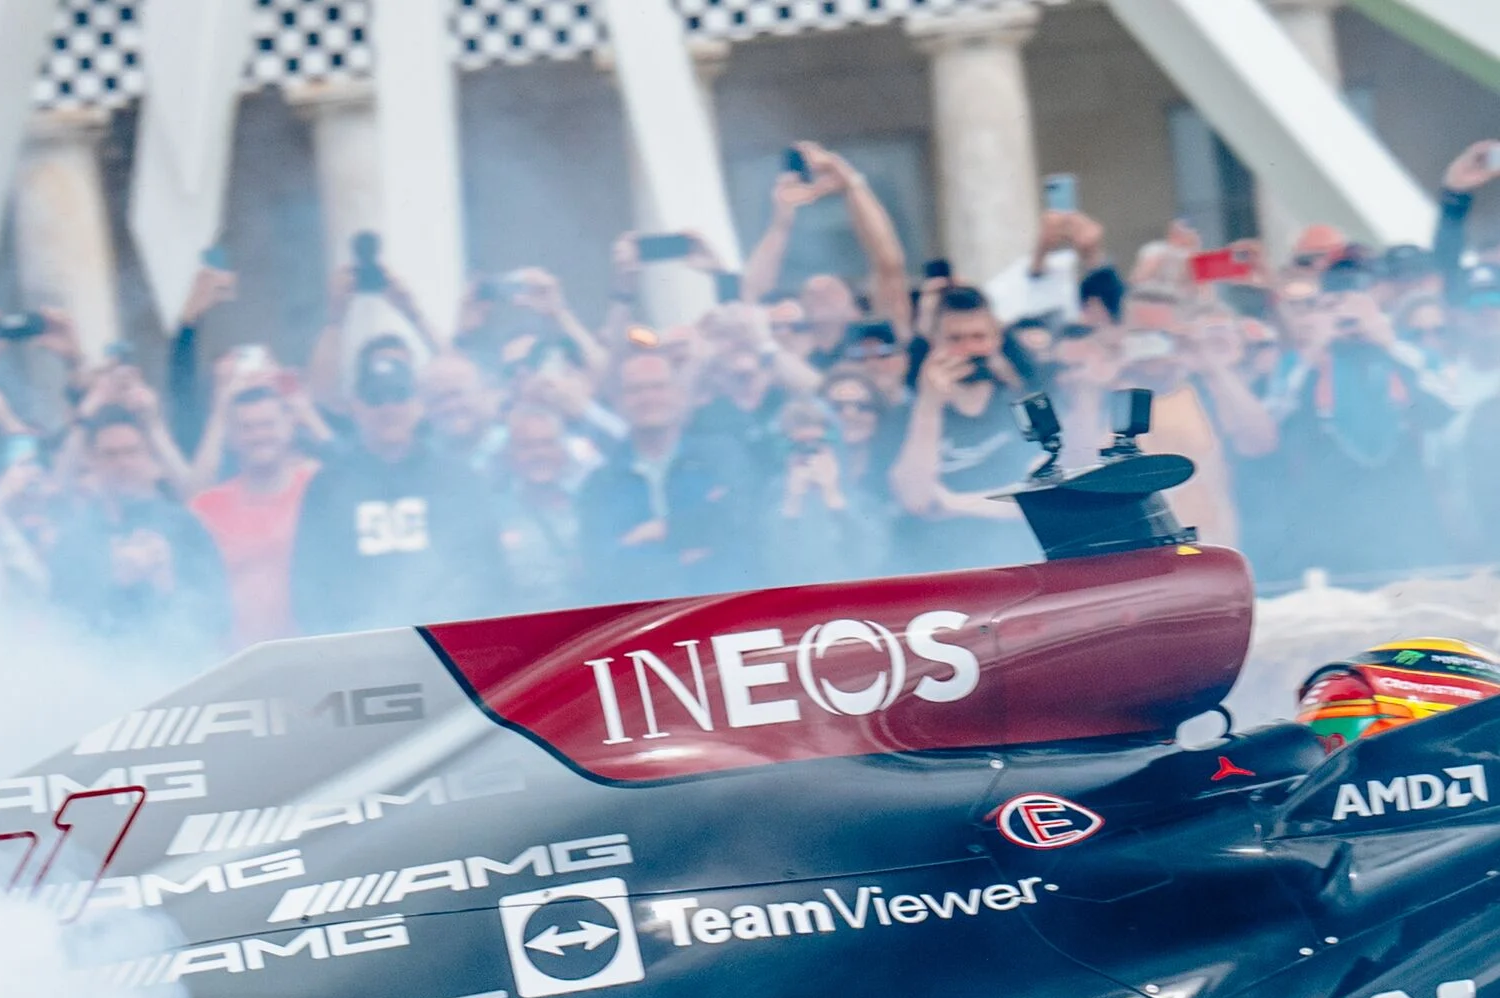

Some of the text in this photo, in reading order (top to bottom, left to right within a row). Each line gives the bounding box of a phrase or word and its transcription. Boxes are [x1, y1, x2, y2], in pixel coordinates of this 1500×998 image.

[583, 610, 981, 745] INEOS
[1332, 774, 1445, 821] AMD
[381, 834, 634, 903] AMG
[653, 876, 1044, 947] TeamViewer
[159, 912, 410, 984] AMG
